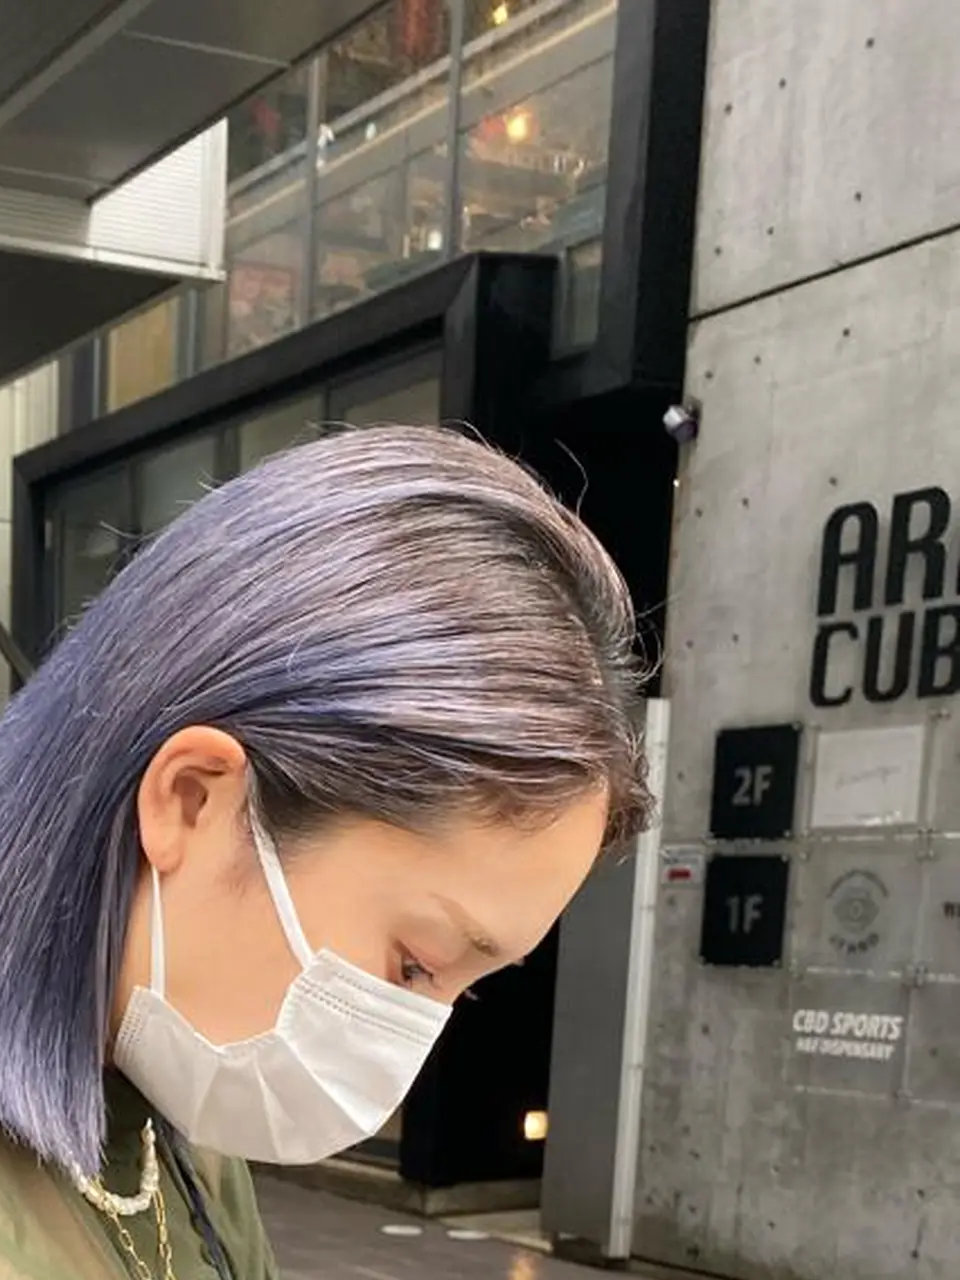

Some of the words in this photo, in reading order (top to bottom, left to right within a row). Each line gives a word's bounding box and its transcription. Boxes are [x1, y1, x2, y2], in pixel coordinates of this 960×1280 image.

[817, 486, 960, 617] AR
[730, 765, 774, 807] 2F
[725, 893, 764, 935] 1F
[792, 1009, 829, 1034] CBD
[830, 1012, 904, 1040] SPORTS
